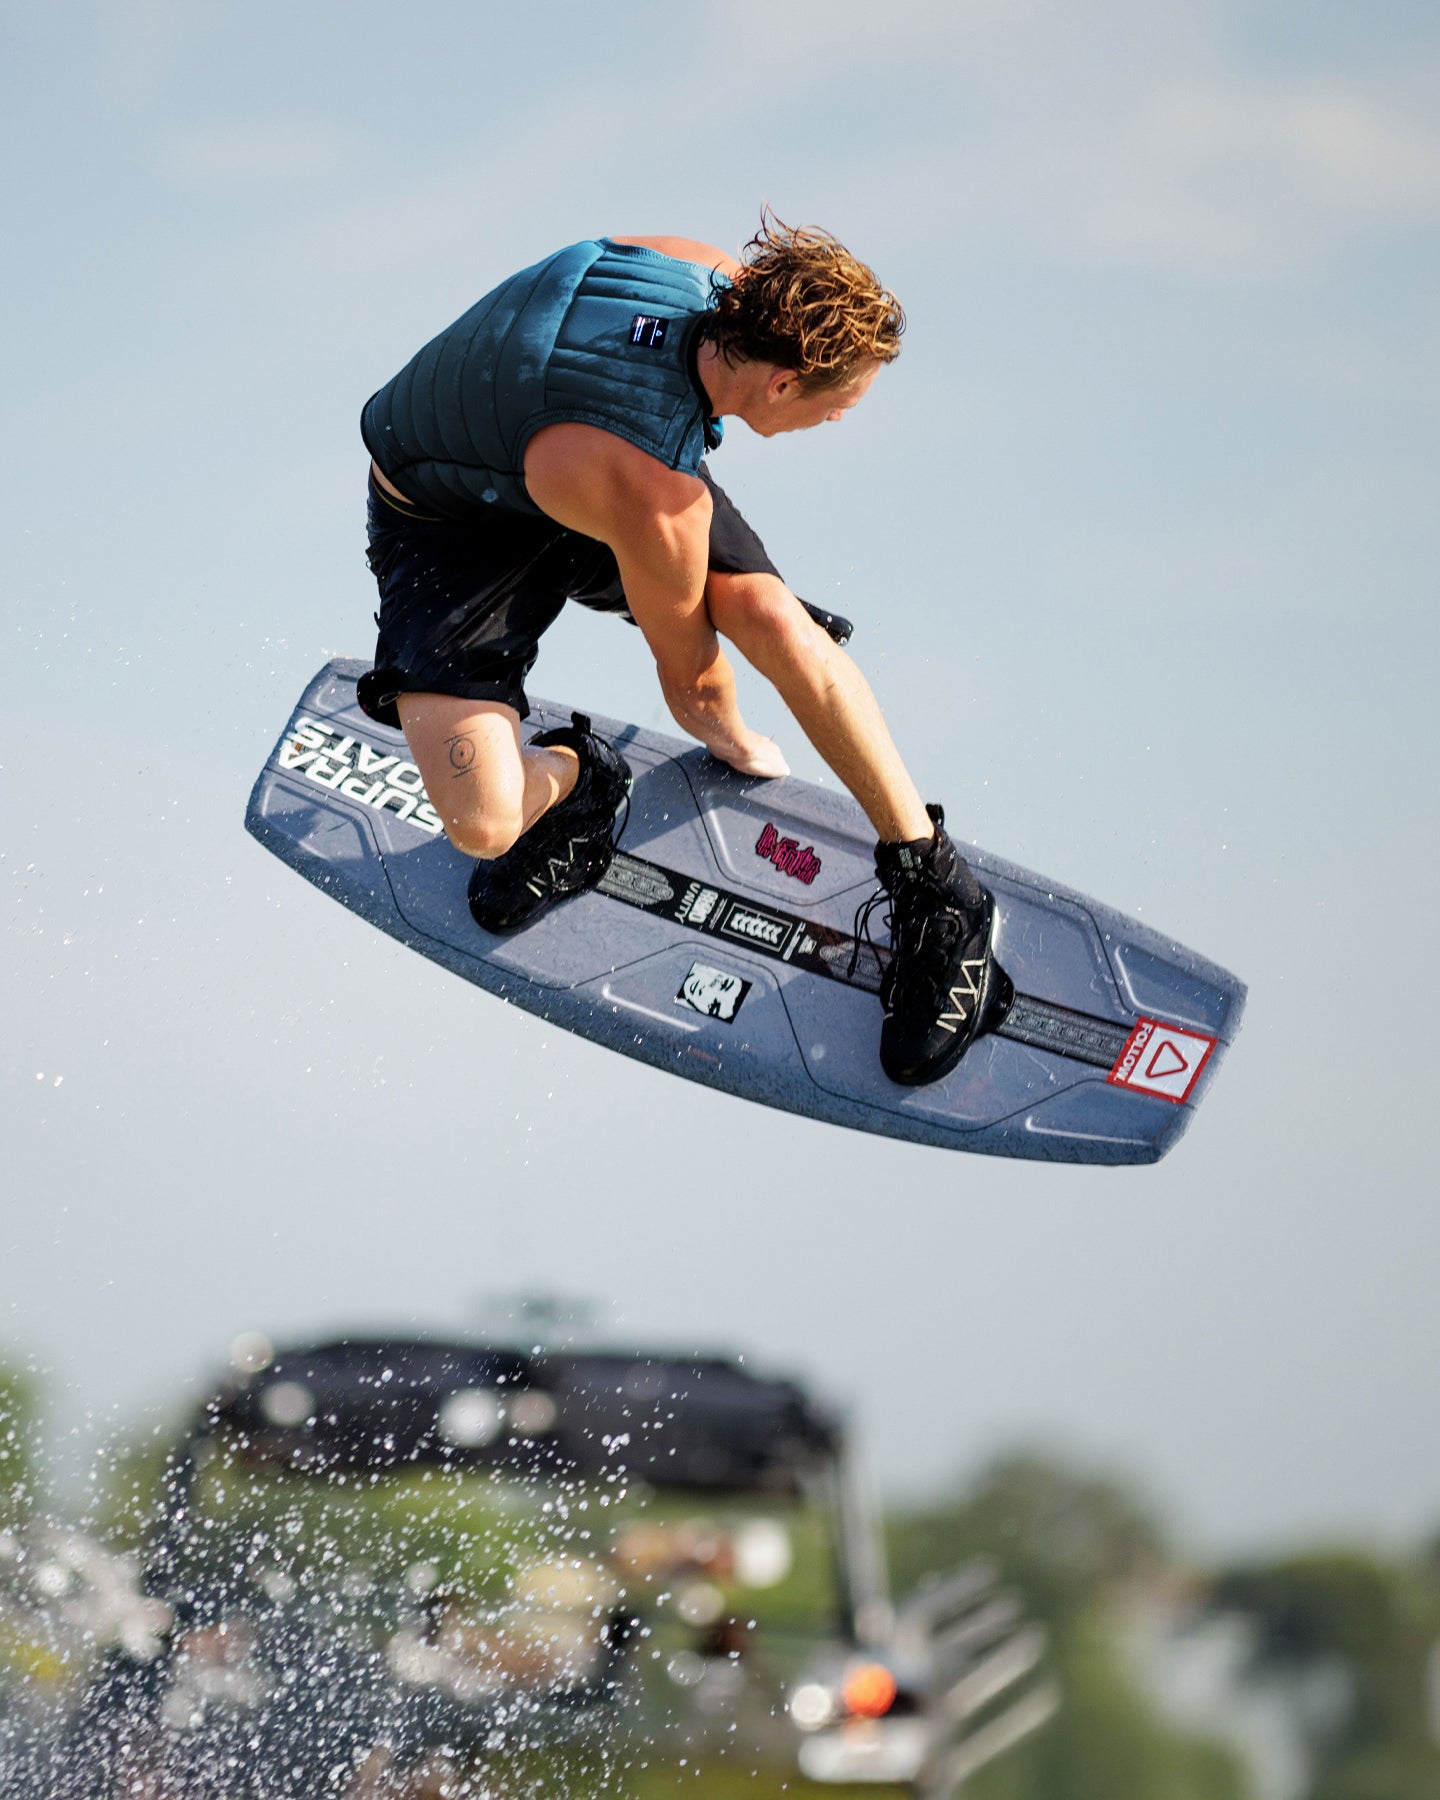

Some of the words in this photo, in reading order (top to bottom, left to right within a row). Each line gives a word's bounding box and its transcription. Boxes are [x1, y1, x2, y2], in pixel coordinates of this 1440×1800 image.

[278, 739, 444, 834] SUPRA
[286, 716, 429, 801] OATS
[674, 882, 700, 924] UNITY
